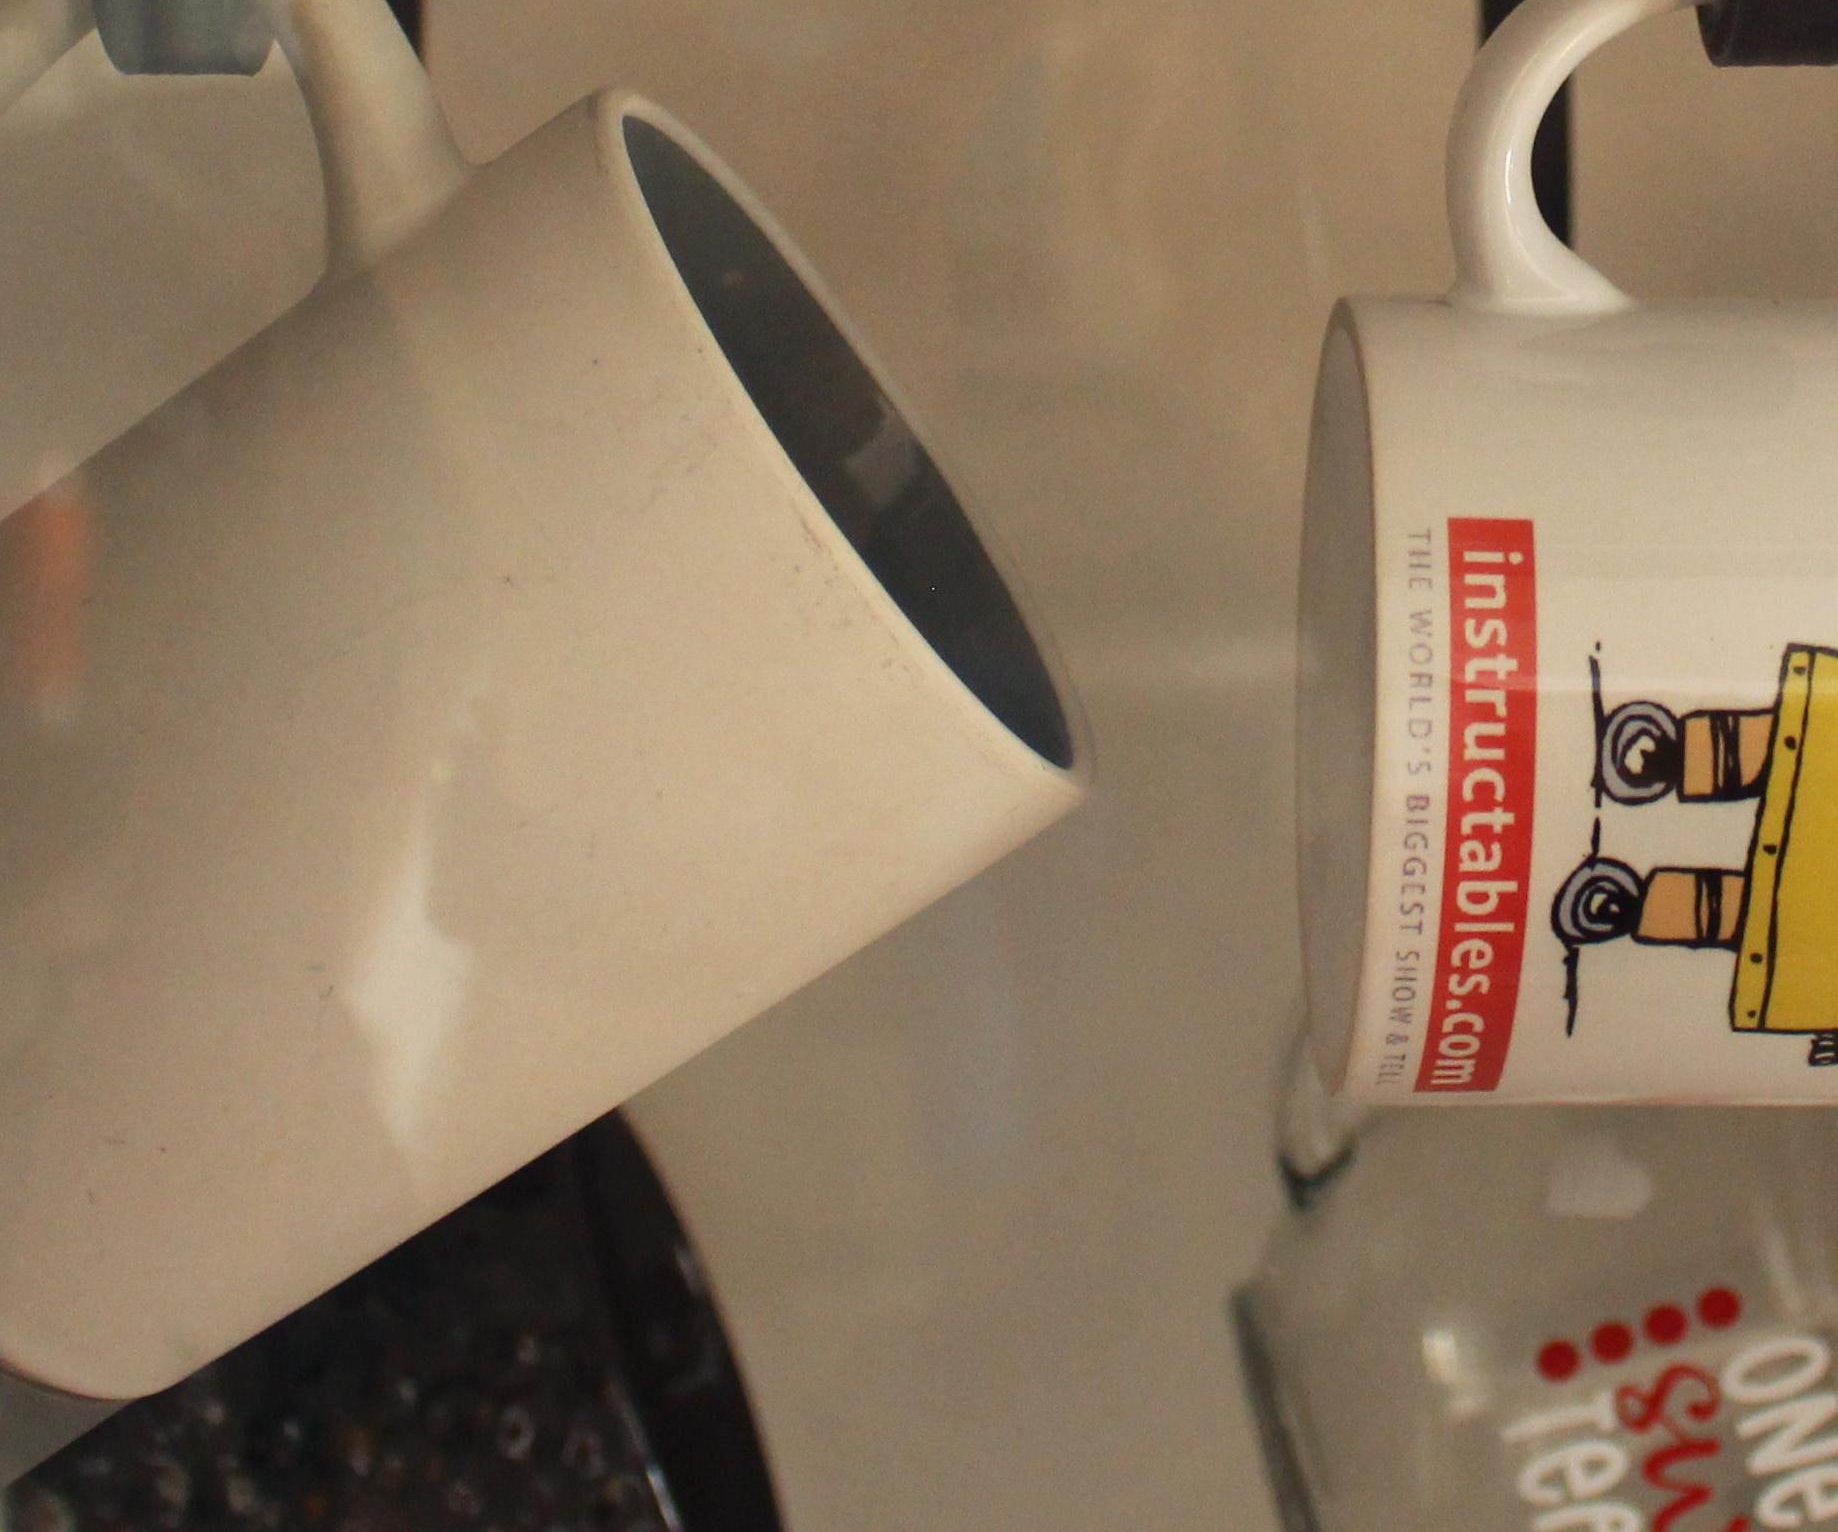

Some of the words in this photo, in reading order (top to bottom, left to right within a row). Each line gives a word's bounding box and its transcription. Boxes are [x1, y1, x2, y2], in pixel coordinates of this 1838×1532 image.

[1407, 527, 1433, 590] THE
[1407, 609, 1434, 776] WORLD'S
[1399, 793, 1431, 936] BIGGEST
[1430, 550, 1525, 1086] instructables.com
[1385, 1032, 1410, 1046] &
[1389, 950, 1421, 1025] SHOW
